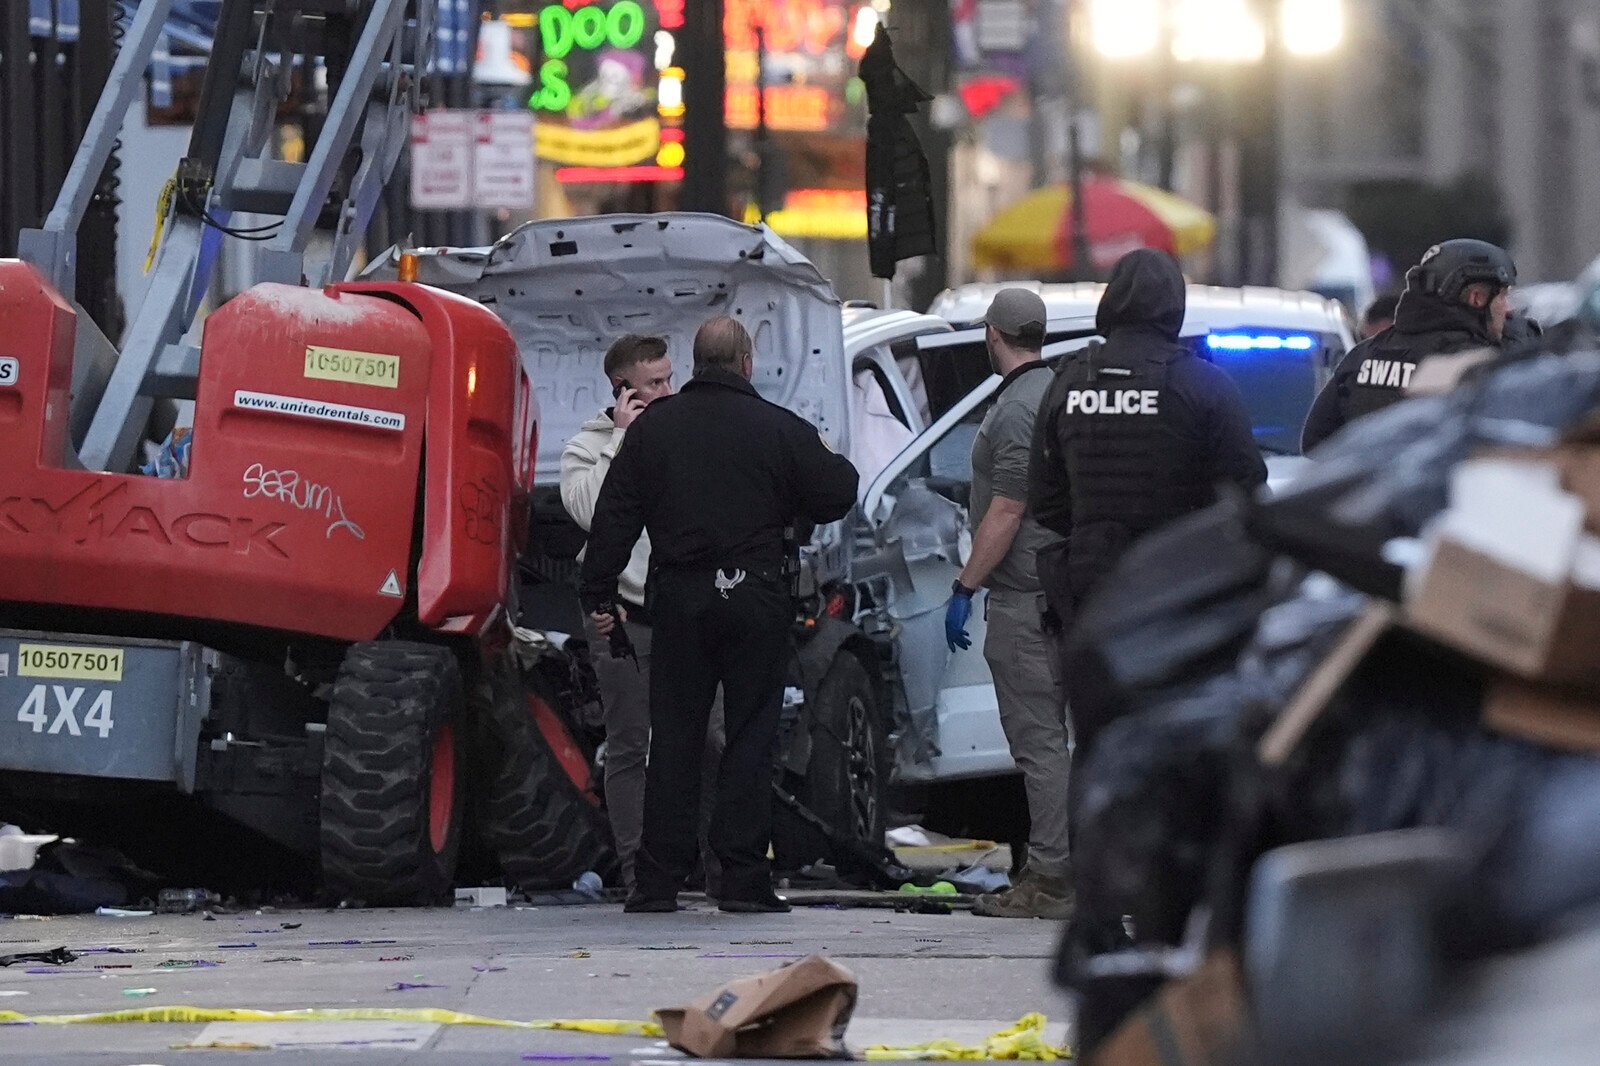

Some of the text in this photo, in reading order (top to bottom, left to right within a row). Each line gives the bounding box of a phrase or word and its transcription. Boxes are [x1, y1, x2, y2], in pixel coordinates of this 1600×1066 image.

[306, 353, 397, 379] 10507501
[1356, 358, 1417, 388] SWAT
[238, 396, 401, 428] www.unitedrentals.com
[1066, 389, 1160, 415] POLICE
[20, 650, 120, 672] 10507501
[17, 684, 115, 738] 4X4
